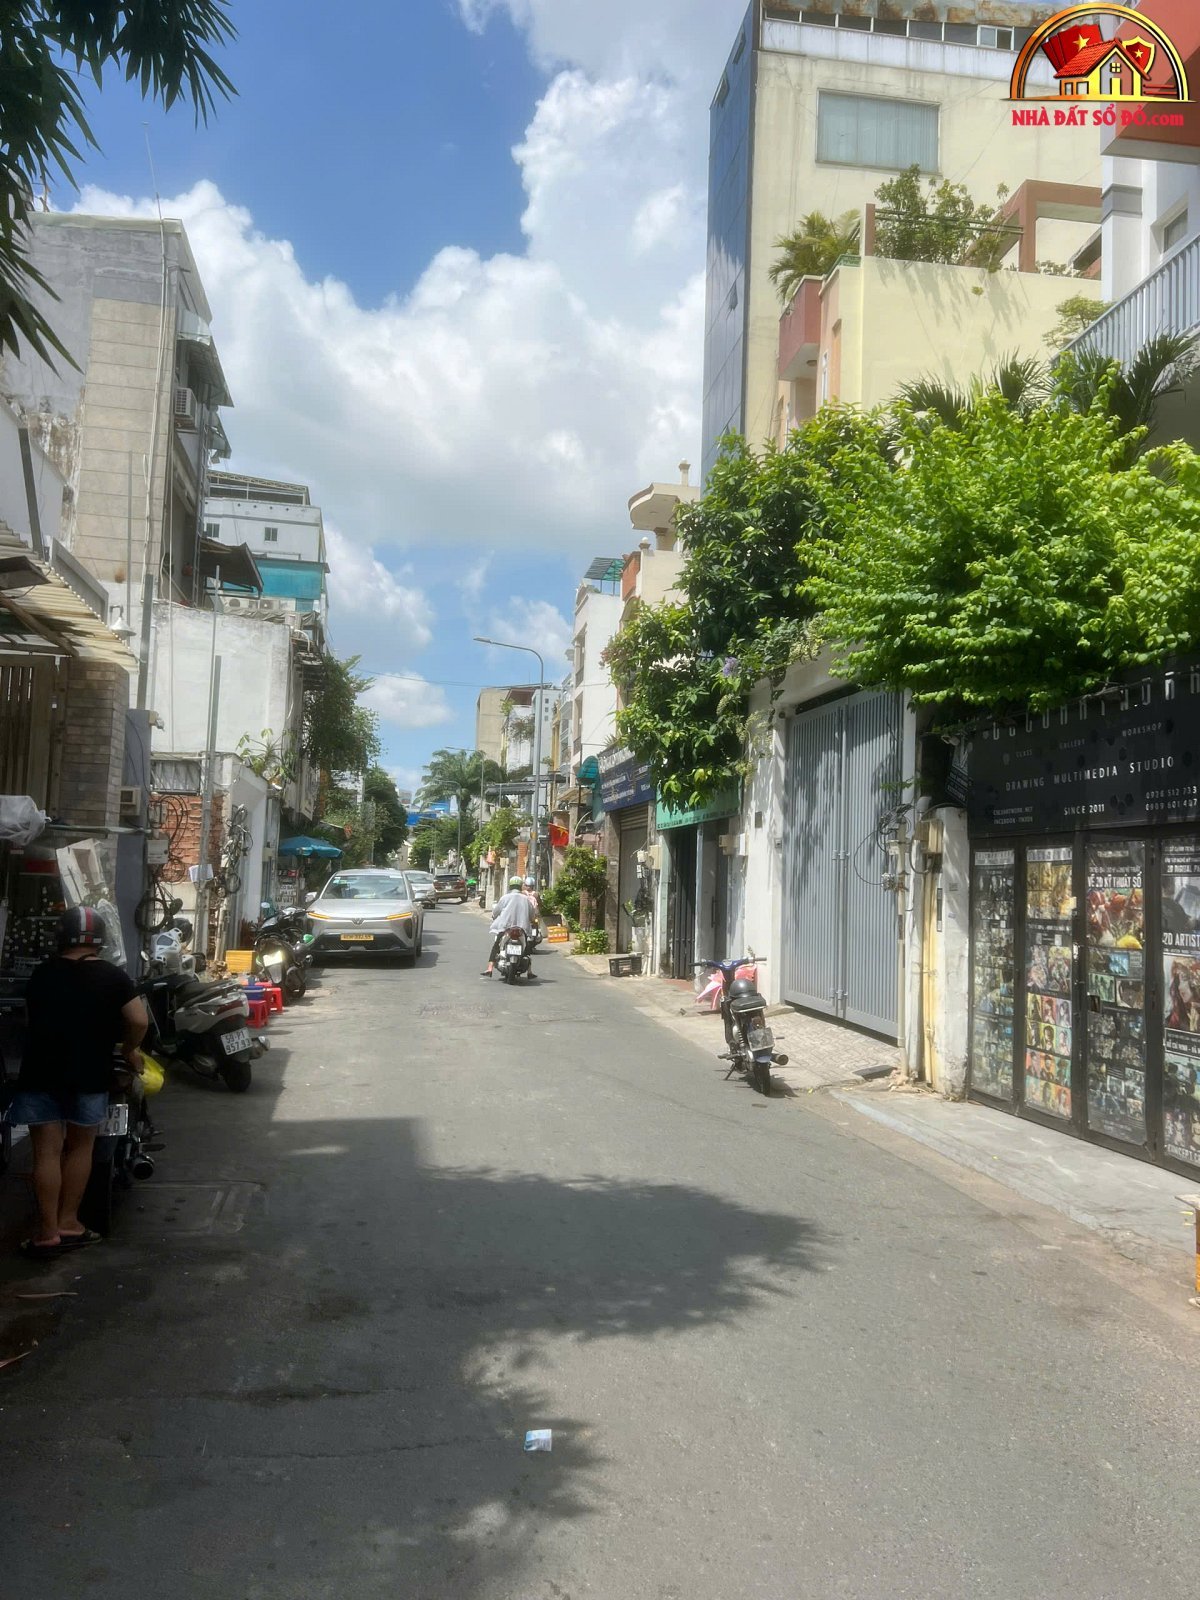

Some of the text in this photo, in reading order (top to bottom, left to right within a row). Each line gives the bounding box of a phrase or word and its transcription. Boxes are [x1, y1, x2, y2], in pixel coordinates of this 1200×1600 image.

[1005, 756, 1174, 791] DRAWING MULTIMEDIA STUDIO
[1064, 803, 1105, 815] SINCE 2011
